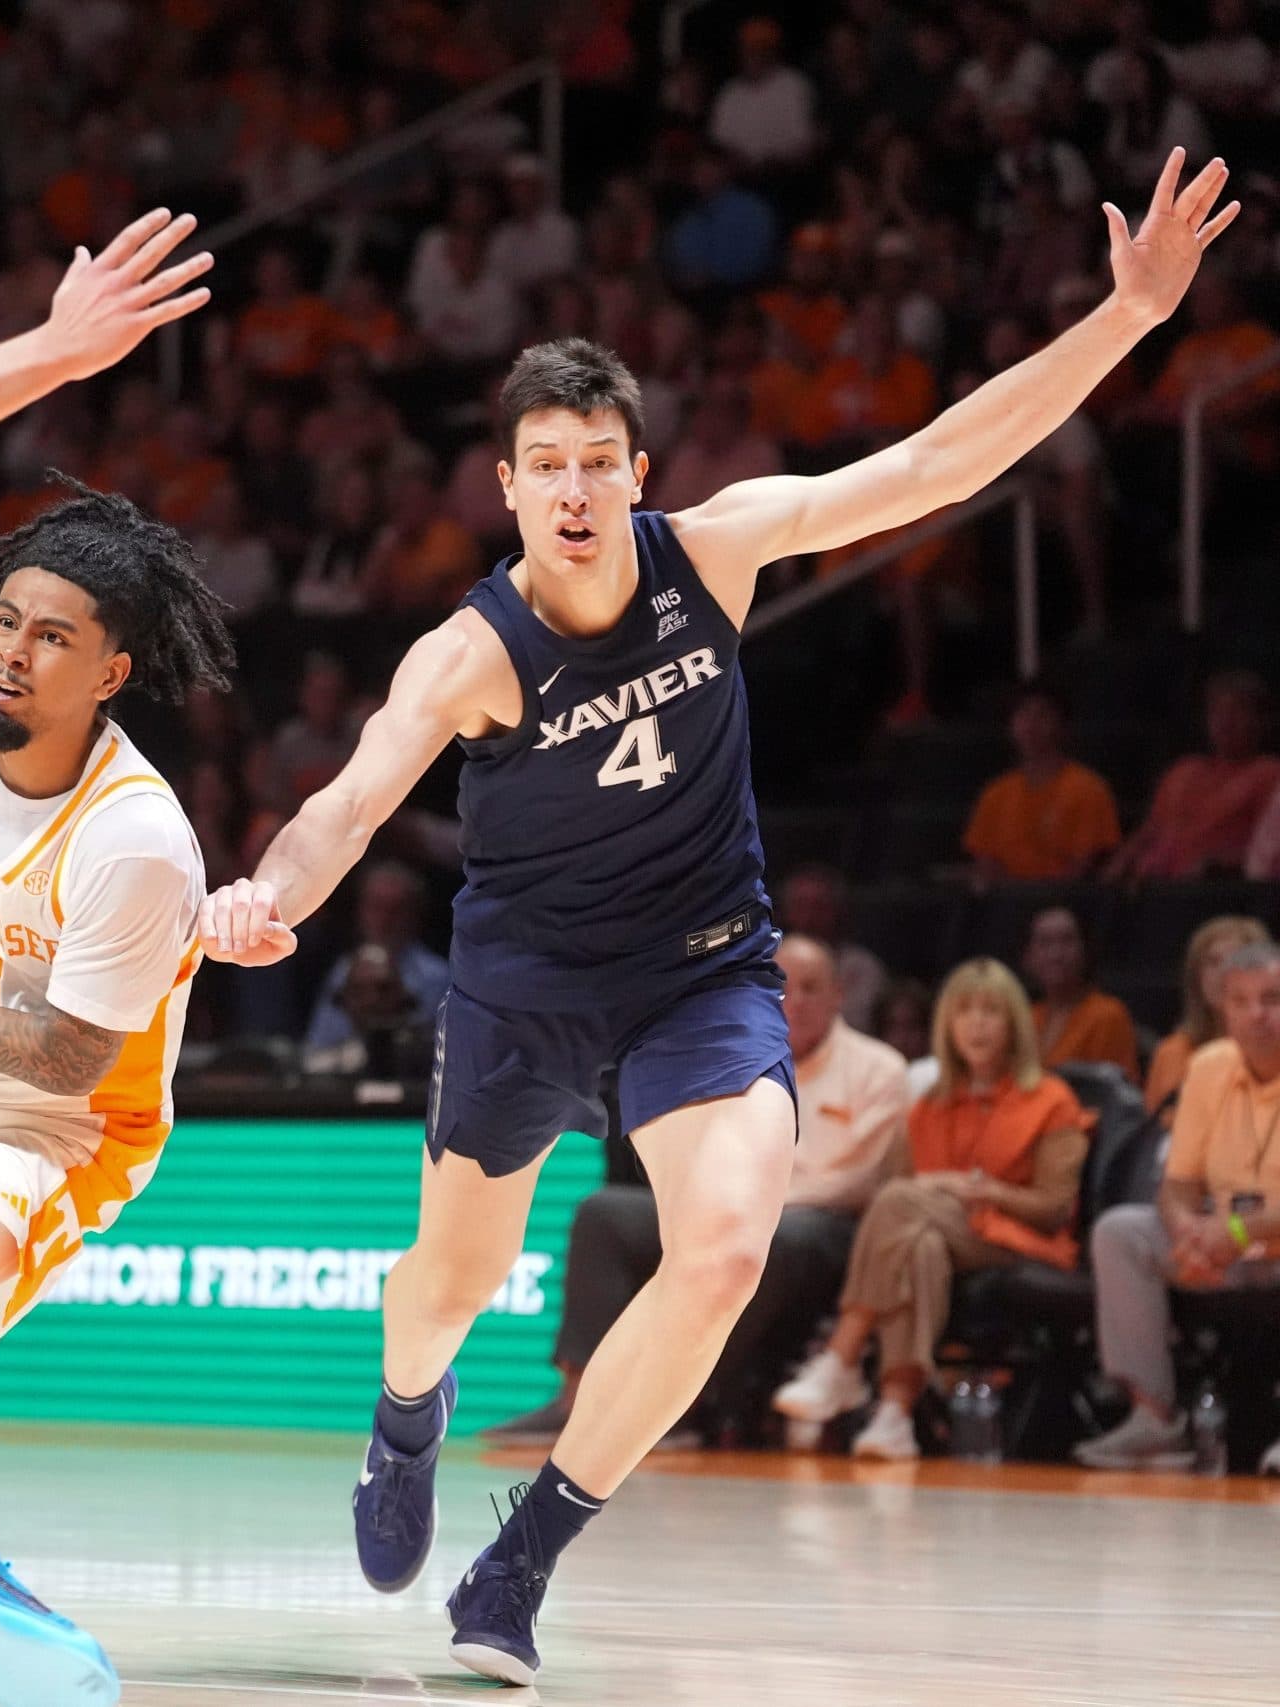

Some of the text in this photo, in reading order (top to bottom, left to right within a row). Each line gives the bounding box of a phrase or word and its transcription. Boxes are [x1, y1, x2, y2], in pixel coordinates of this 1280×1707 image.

[657, 614, 689, 637] EAST
[659, 609, 680, 628] BIG
[532, 646, 724, 750] XAVIER
[597, 714, 677, 792] 4
[42, 1244, 184, 1306] NION
